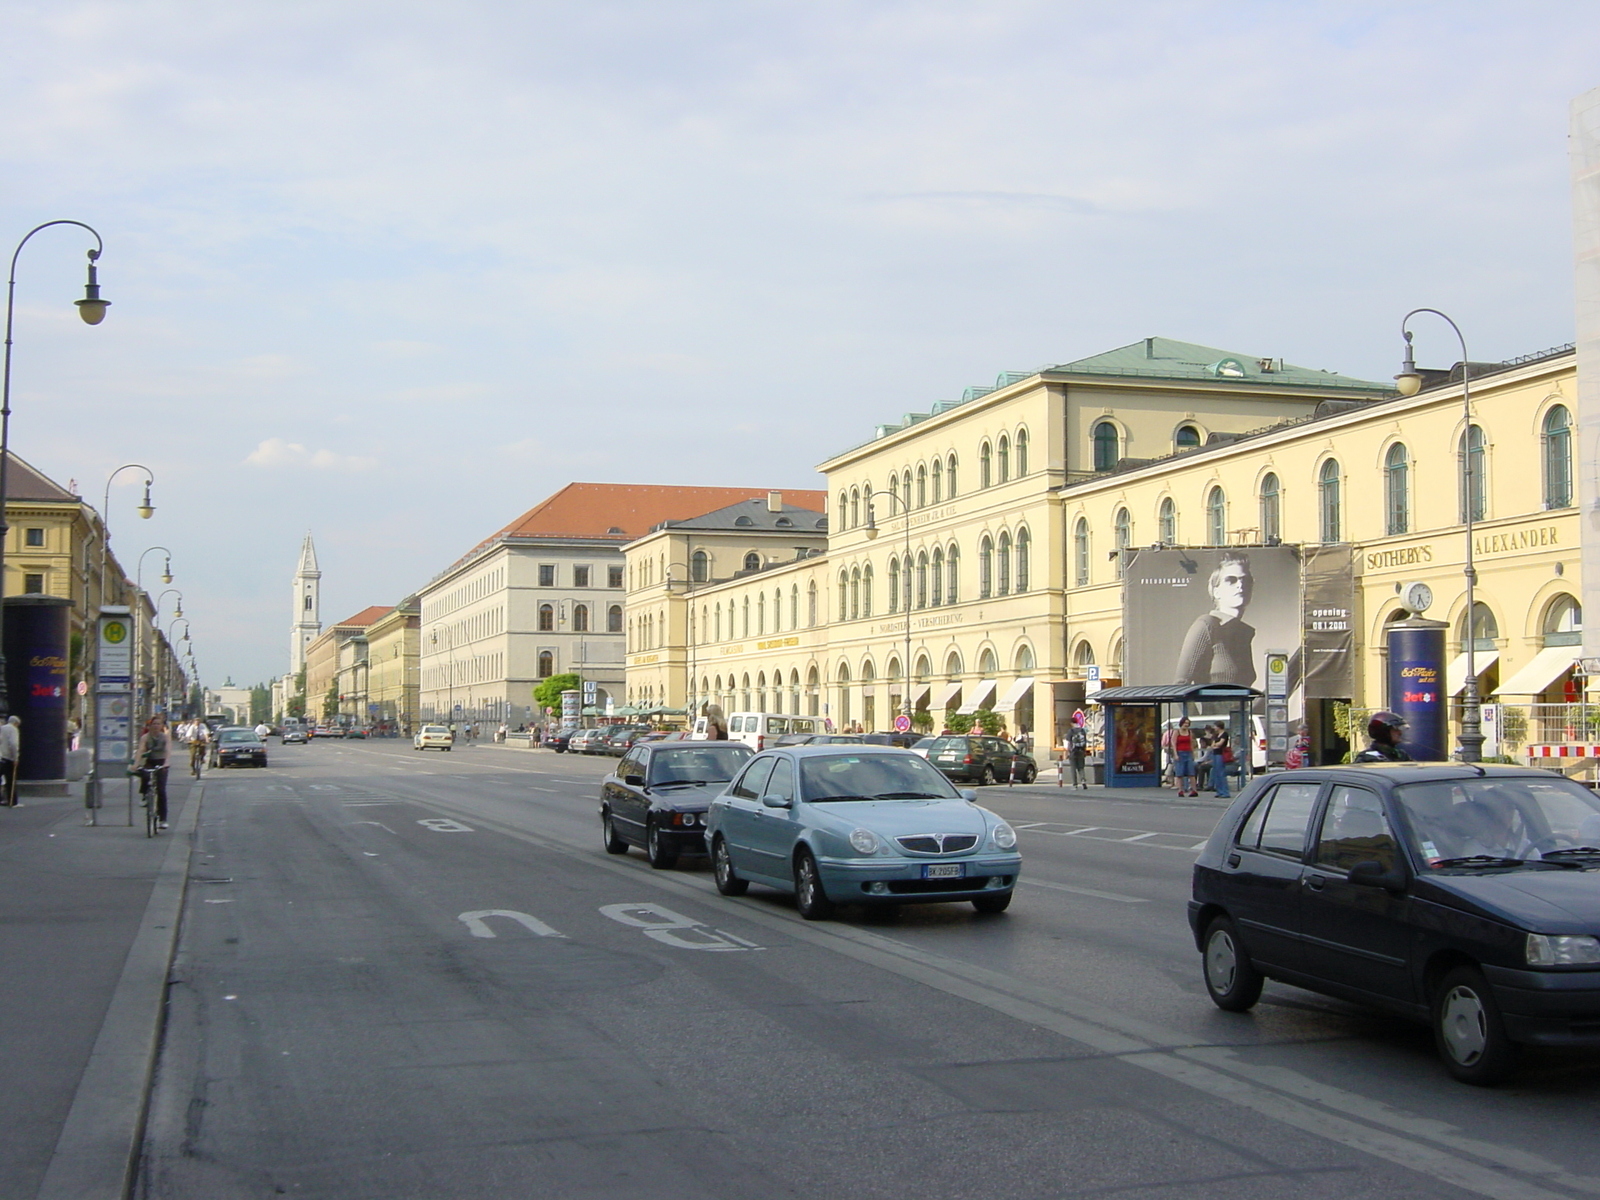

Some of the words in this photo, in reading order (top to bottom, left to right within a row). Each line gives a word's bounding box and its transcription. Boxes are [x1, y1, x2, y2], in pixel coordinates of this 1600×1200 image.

[1475, 526, 1558, 555] ALEXANDER
[1367, 545, 1432, 569] SOTHEBY'S
[1312, 607, 1346, 618] opening
[879, 620, 911, 633] NORDSTER
[1089, 667, 1097, 679] P
[587, 682, 595, 692] U
